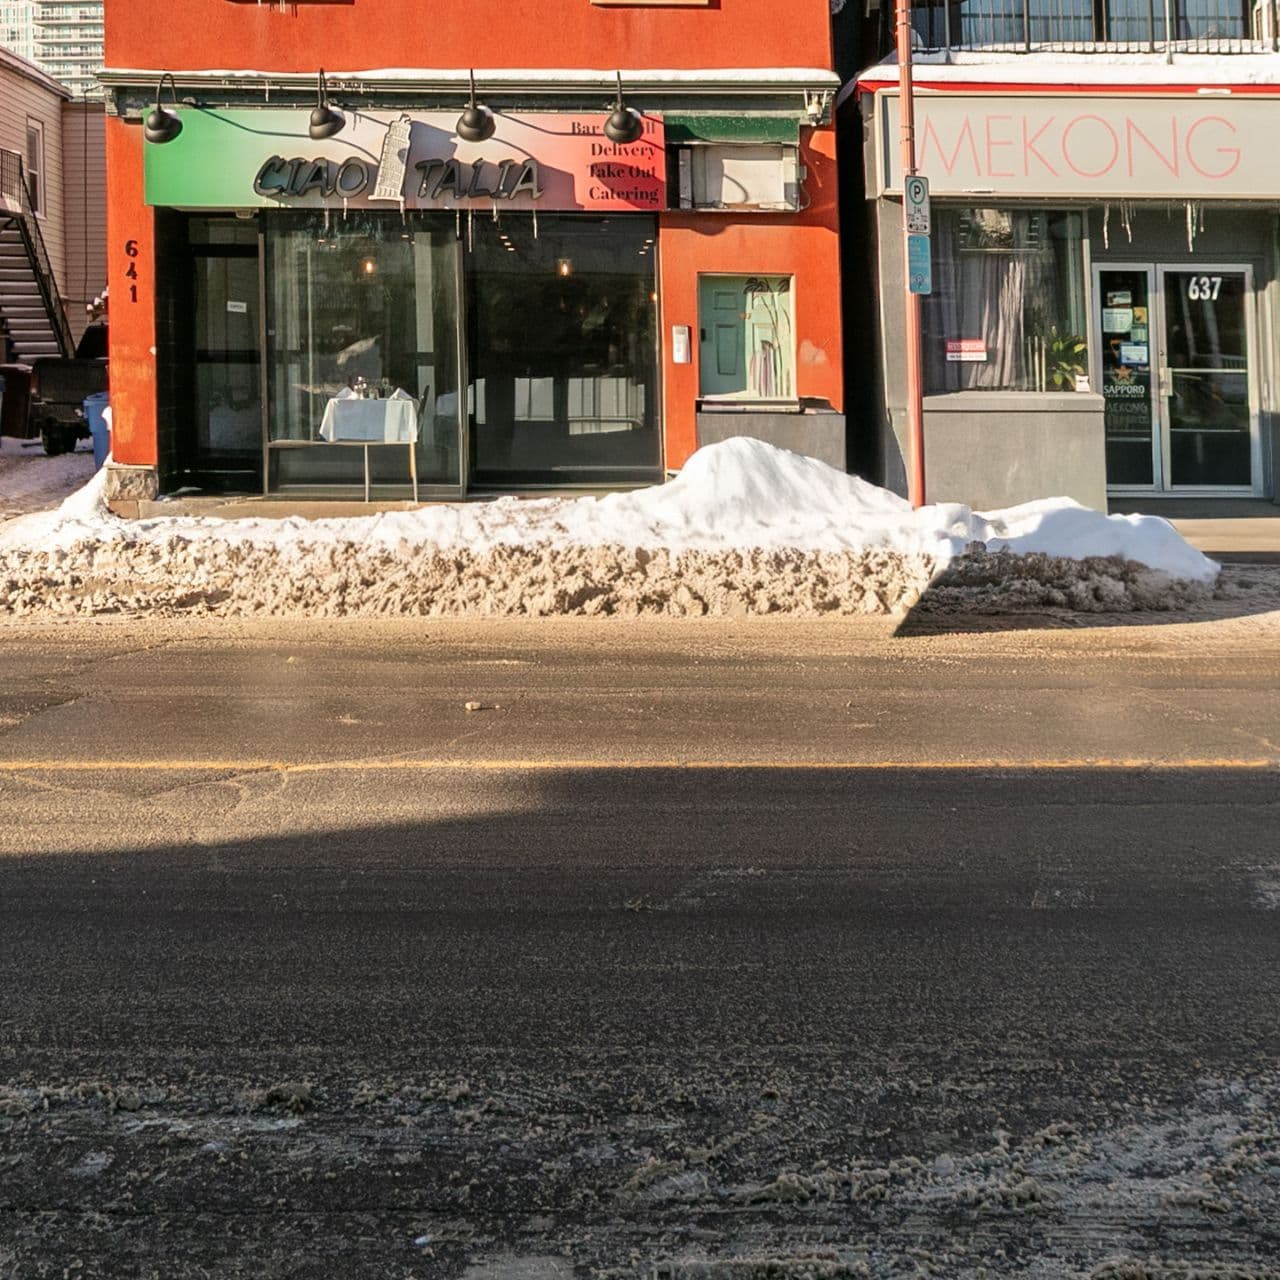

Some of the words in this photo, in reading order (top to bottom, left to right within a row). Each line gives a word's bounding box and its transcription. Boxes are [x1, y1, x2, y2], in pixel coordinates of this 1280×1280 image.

[571, 121, 600, 135] Bar
[591, 143, 656, 161] Delivery
[918, 114, 1241, 180] MEKONG
[253, 155, 369, 198] CIAO
[586, 164, 625, 178] Take
[628, 165, 656, 178] Out
[588, 186, 659, 205] Catering
[913, 185, 921, 199] P
[124, 239, 139, 304] 641
[1188, 276, 1222, 300] 637
[1103, 384, 1146, 394] SAPPORO
